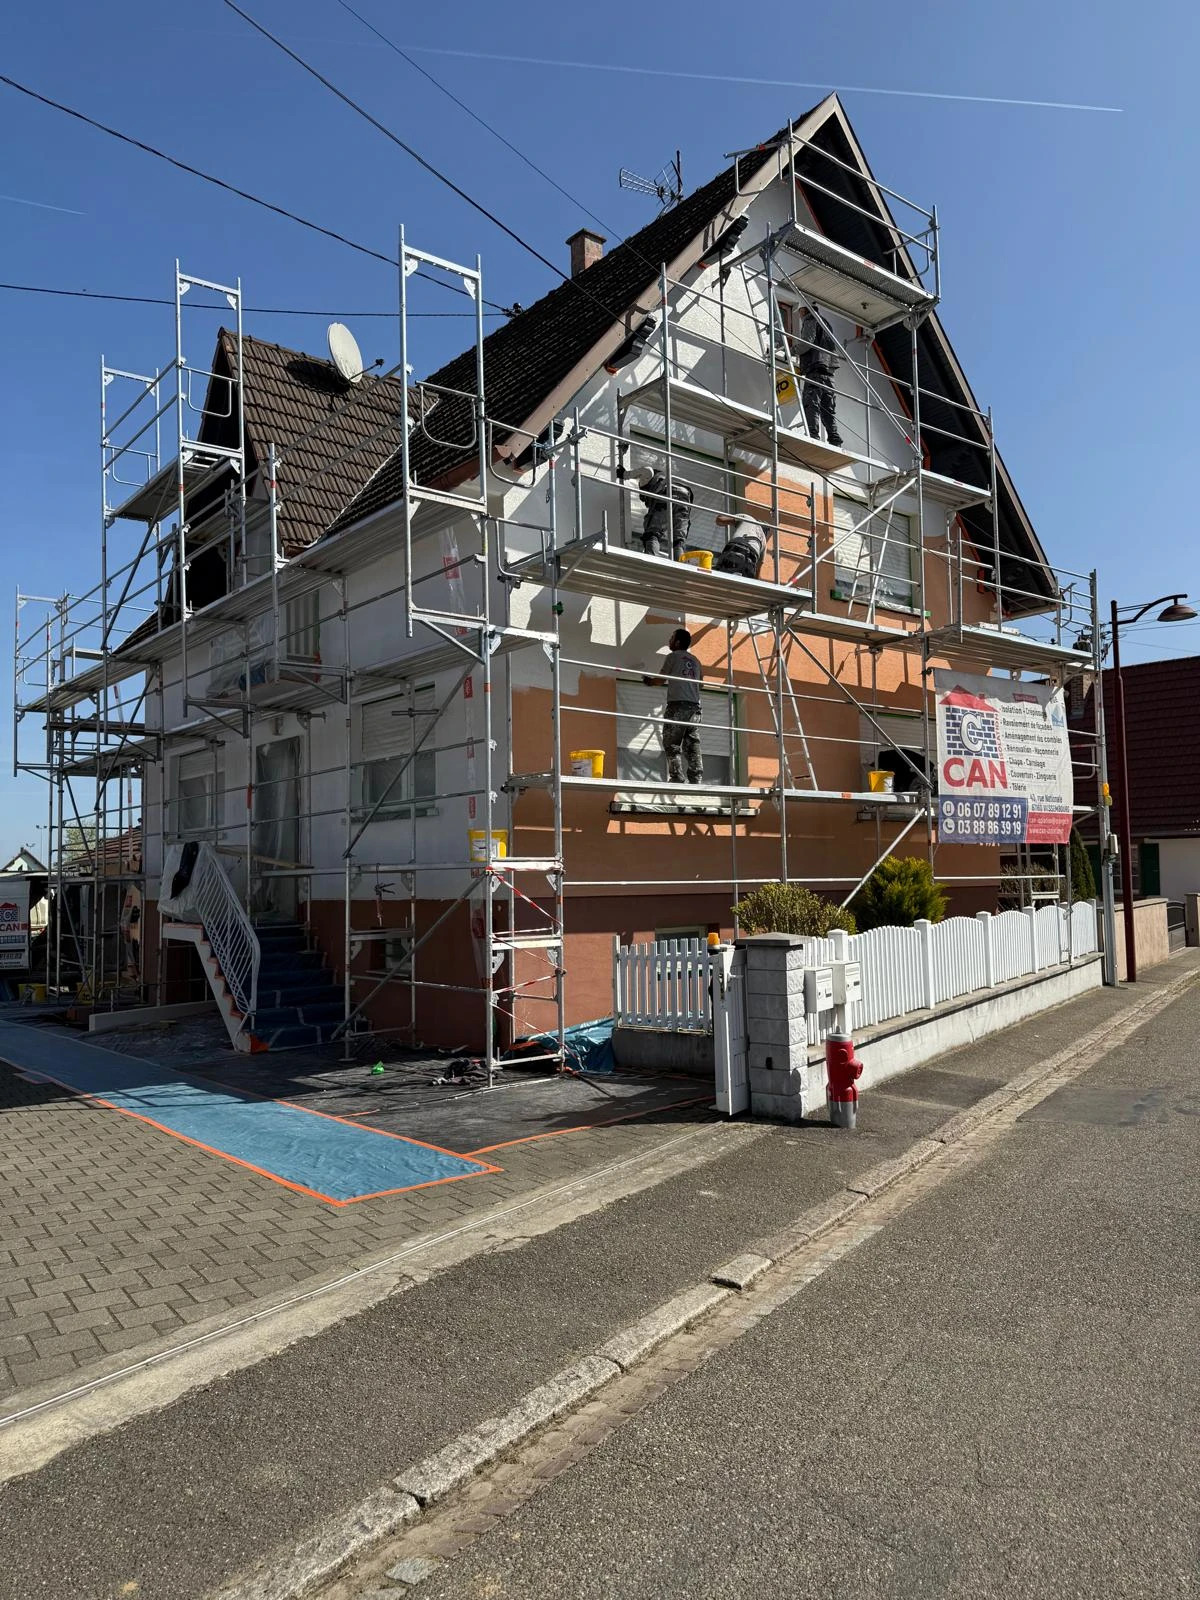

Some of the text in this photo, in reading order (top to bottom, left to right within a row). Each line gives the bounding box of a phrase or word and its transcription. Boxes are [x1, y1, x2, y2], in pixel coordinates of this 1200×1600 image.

[1001, 705, 1023, 714] Isolation
[943, 757, 1008, 789] CAN
[957, 802, 1022, 819] 06 07 89 12 91
[957, 820, 1022, 835] 03 88 86 39 19
[0, 923, 19, 931] CAN
